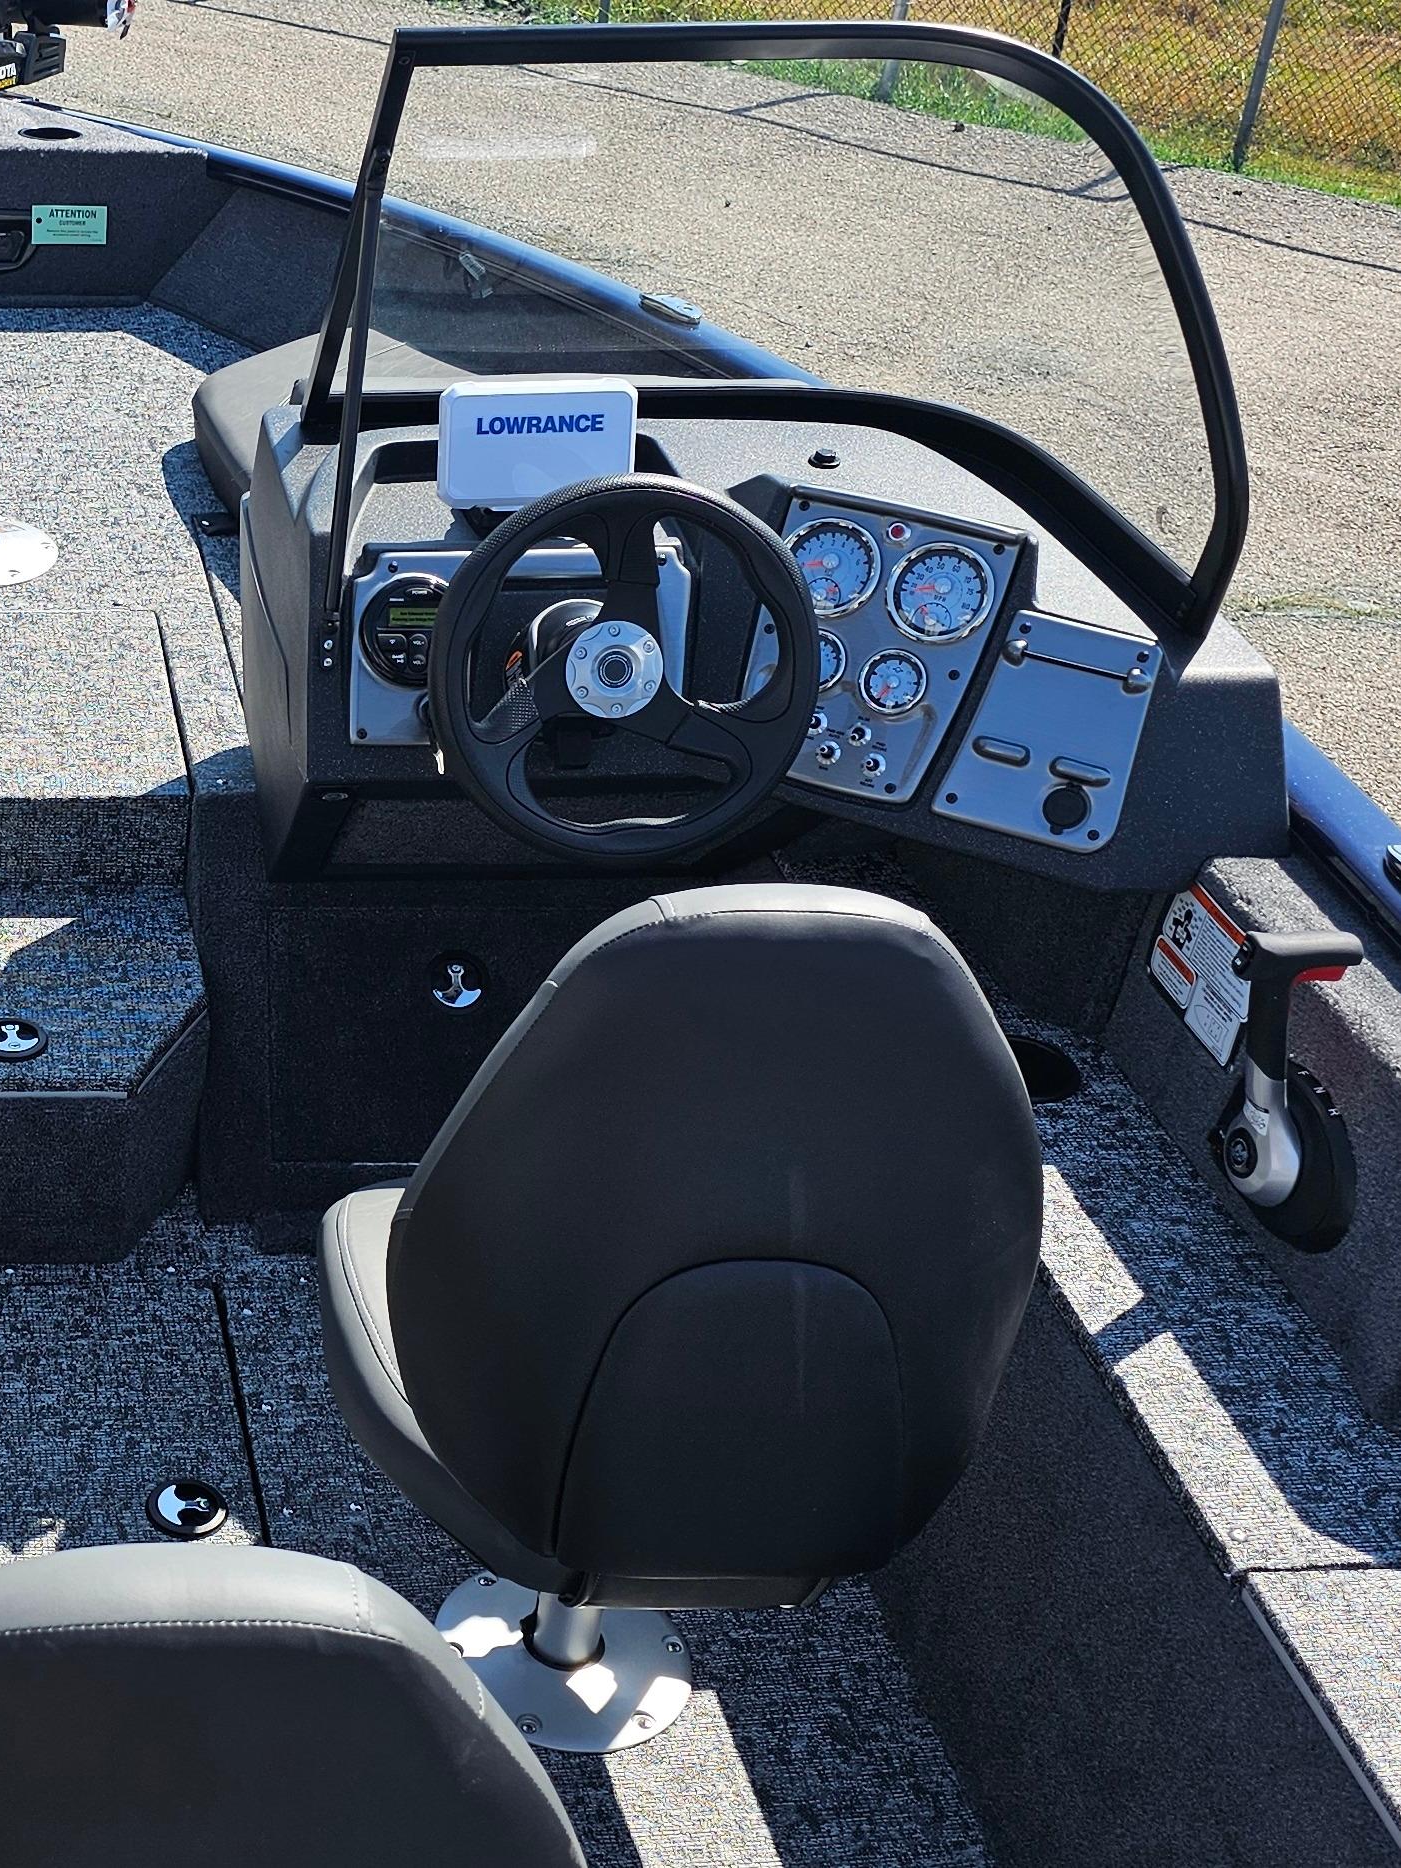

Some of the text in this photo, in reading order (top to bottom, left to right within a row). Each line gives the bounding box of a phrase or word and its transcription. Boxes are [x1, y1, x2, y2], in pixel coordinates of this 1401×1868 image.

[48, 208, 97, 219] ATTENTION
[476, 414, 605, 435] LOWRANCE
[924, 565, 934, 574] 40
[936, 561, 946, 571] 50
[952, 565, 961, 574] 60
[915, 572, 925, 581] 30
[961, 602, 971, 611] 80
[1313, 1086, 1326, 1094] N
[1327, 1108, 1340, 1116] R
